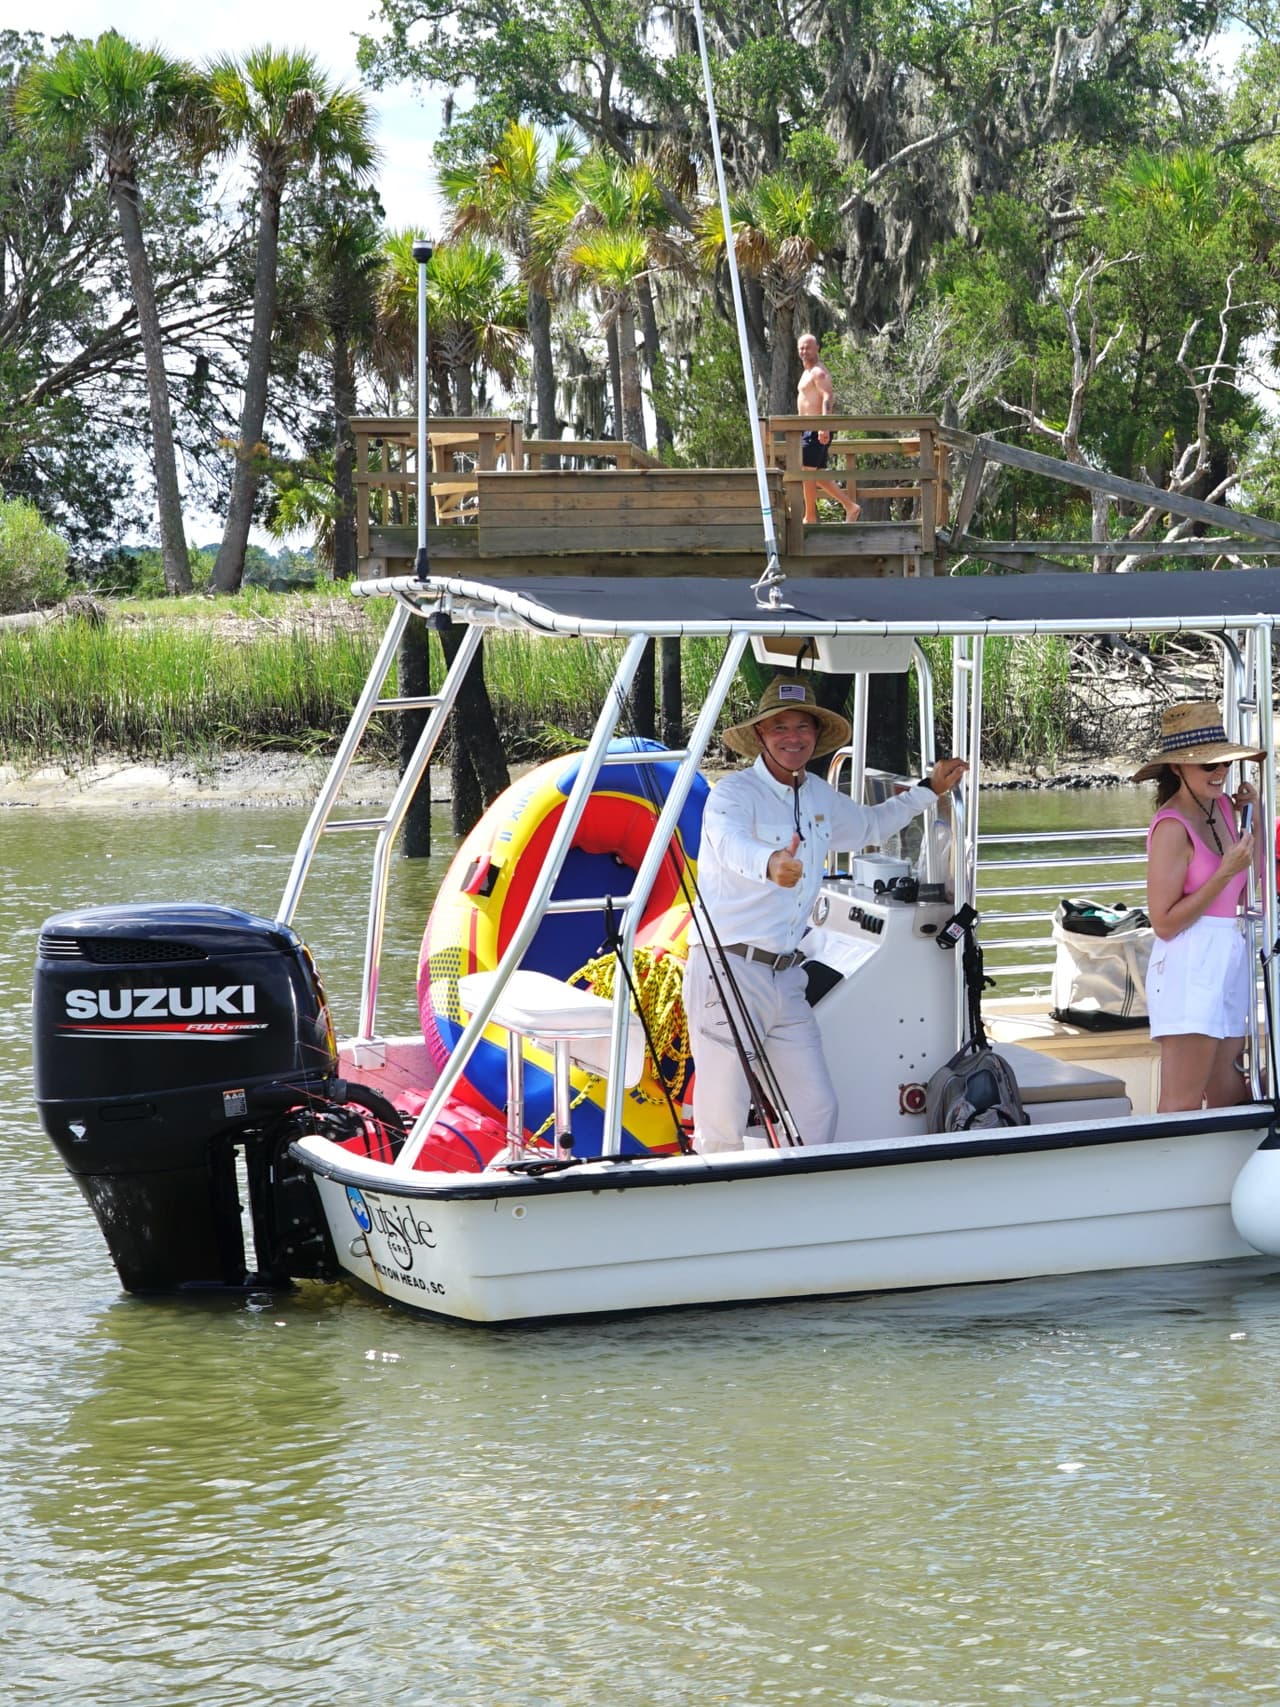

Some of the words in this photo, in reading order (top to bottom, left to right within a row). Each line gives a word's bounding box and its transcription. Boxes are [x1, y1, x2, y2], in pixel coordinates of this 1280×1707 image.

[65, 985, 255, 1019] SUZUKI
[345, 1185, 437, 1271] Outside
[400, 1273, 431, 1294] HEAD,
[430, 1281, 446, 1295] SC
